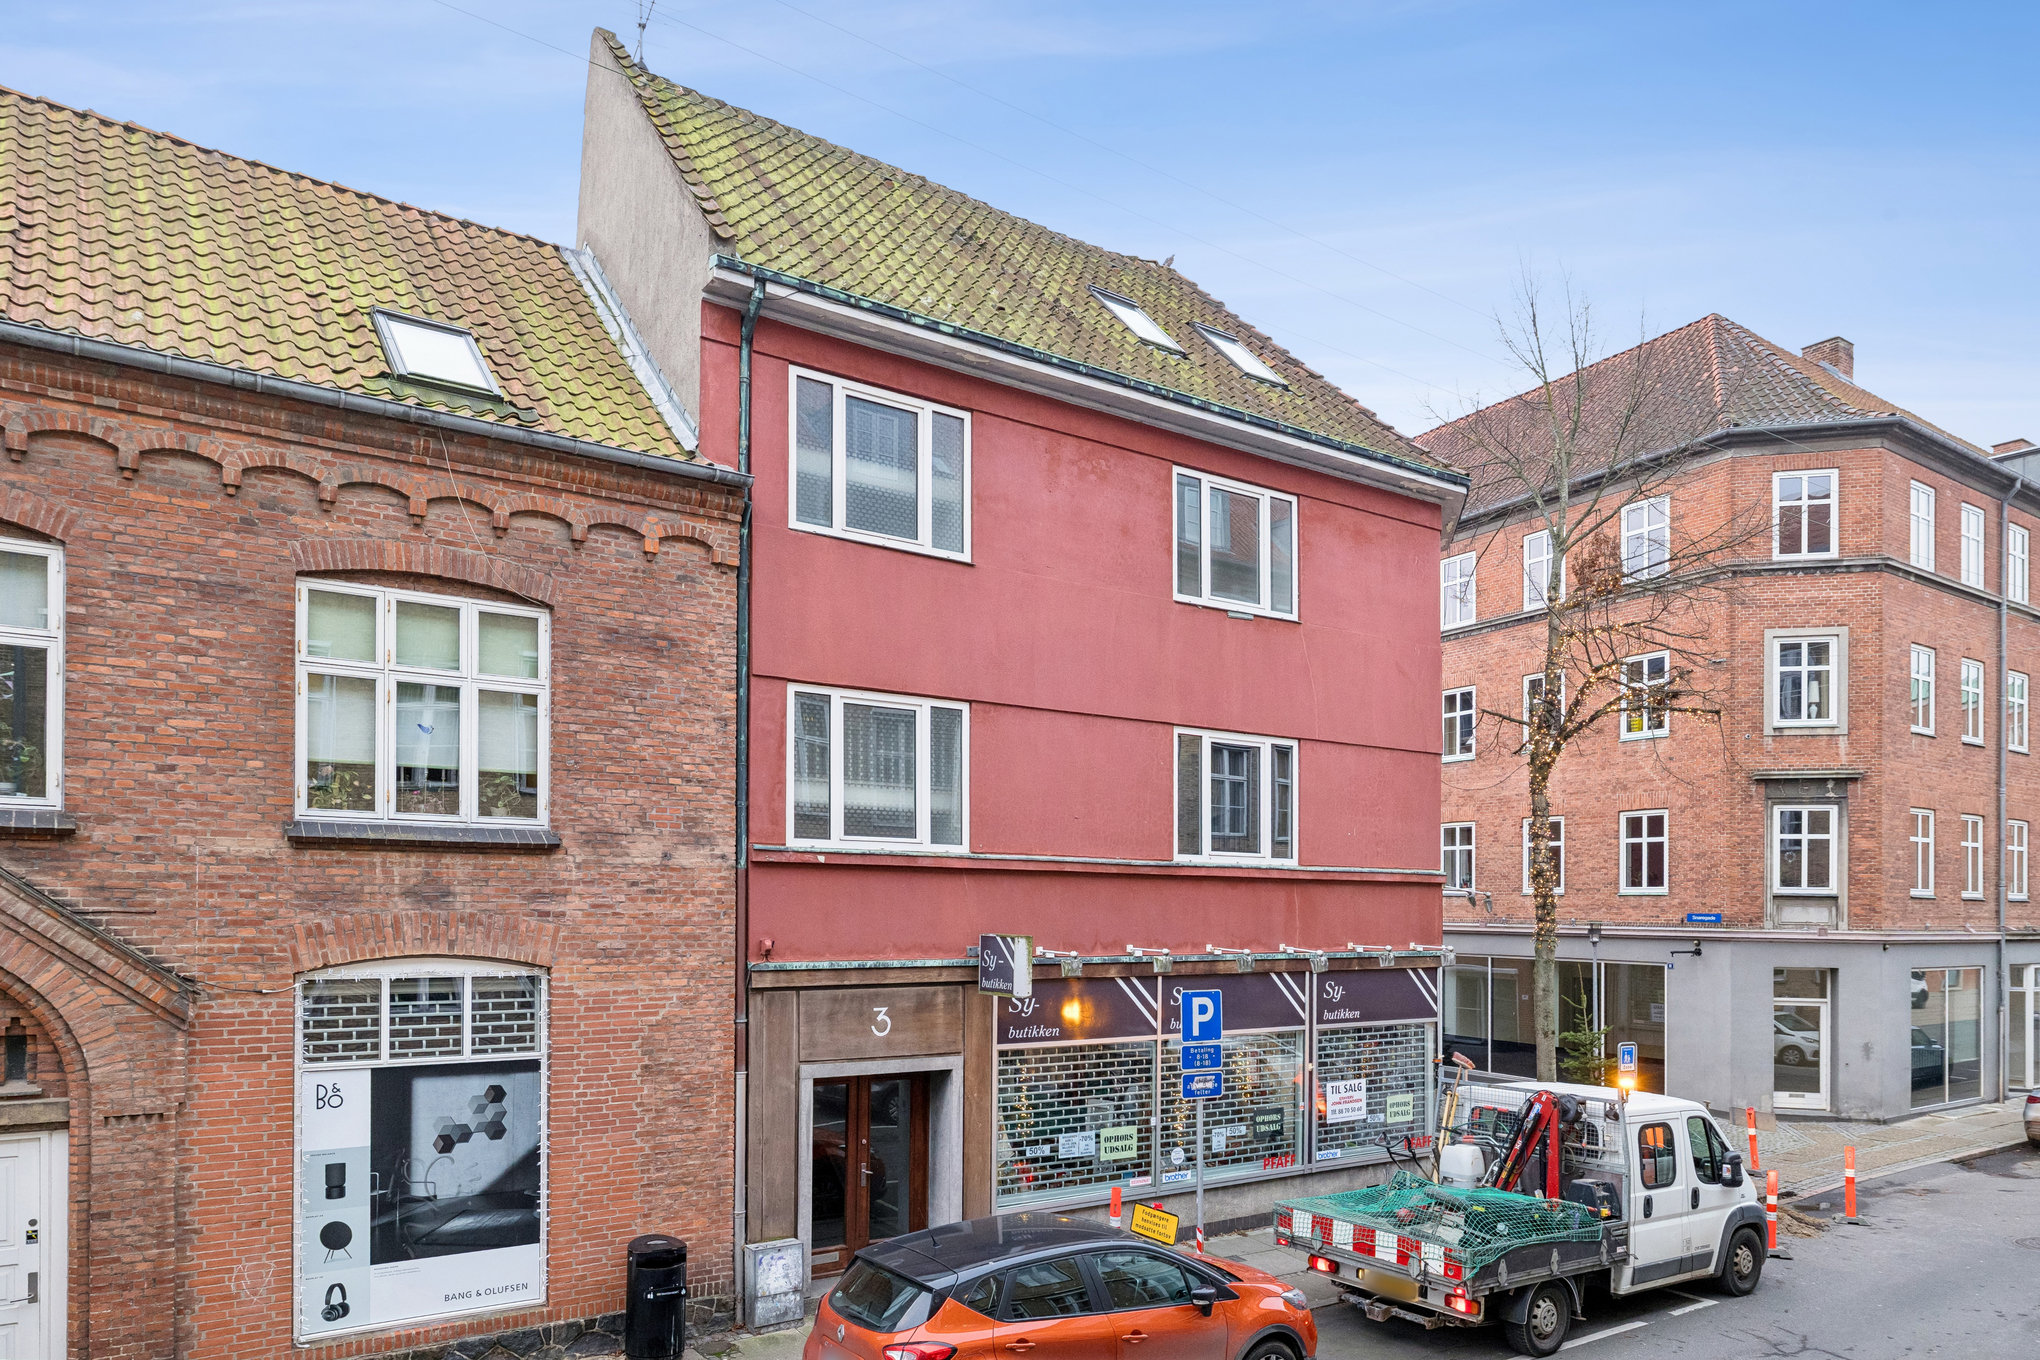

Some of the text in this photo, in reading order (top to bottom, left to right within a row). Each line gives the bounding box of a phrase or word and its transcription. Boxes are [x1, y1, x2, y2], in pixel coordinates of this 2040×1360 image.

[981, 977, 1013, 991] butikken
[1323, 980, 1346, 1002] Sy-
[1192, 996, 1214, 1037] P
[1323, 1008, 1360, 1020] butikken
[871, 1006, 892, 1037] 3
[1008, 1025, 1060, 1039] butikken
[1194, 1088, 1211, 1096] felter
[1331, 1082, 1362, 1095] TIL SALG
[1389, 1109, 1411, 1118] UDSALG
[1229, 1127, 1242, 1135] 50%
[1256, 1123, 1281, 1133] UDSALG
[1028, 1146, 1046, 1156] 50%
[1104, 1144, 1134, 1155] UDSALG
[1317, 1150, 1339, 1160] brother
[1263, 1154, 1296, 1170] PFAFF
[1165, 1172, 1188, 1182] brother
[1142, 1209, 1169, 1223] Fodgængere
[1135, 1223, 1171, 1239] modsatte fortov
[444, 1282, 529, 1302] BANG & OLUFSEN
